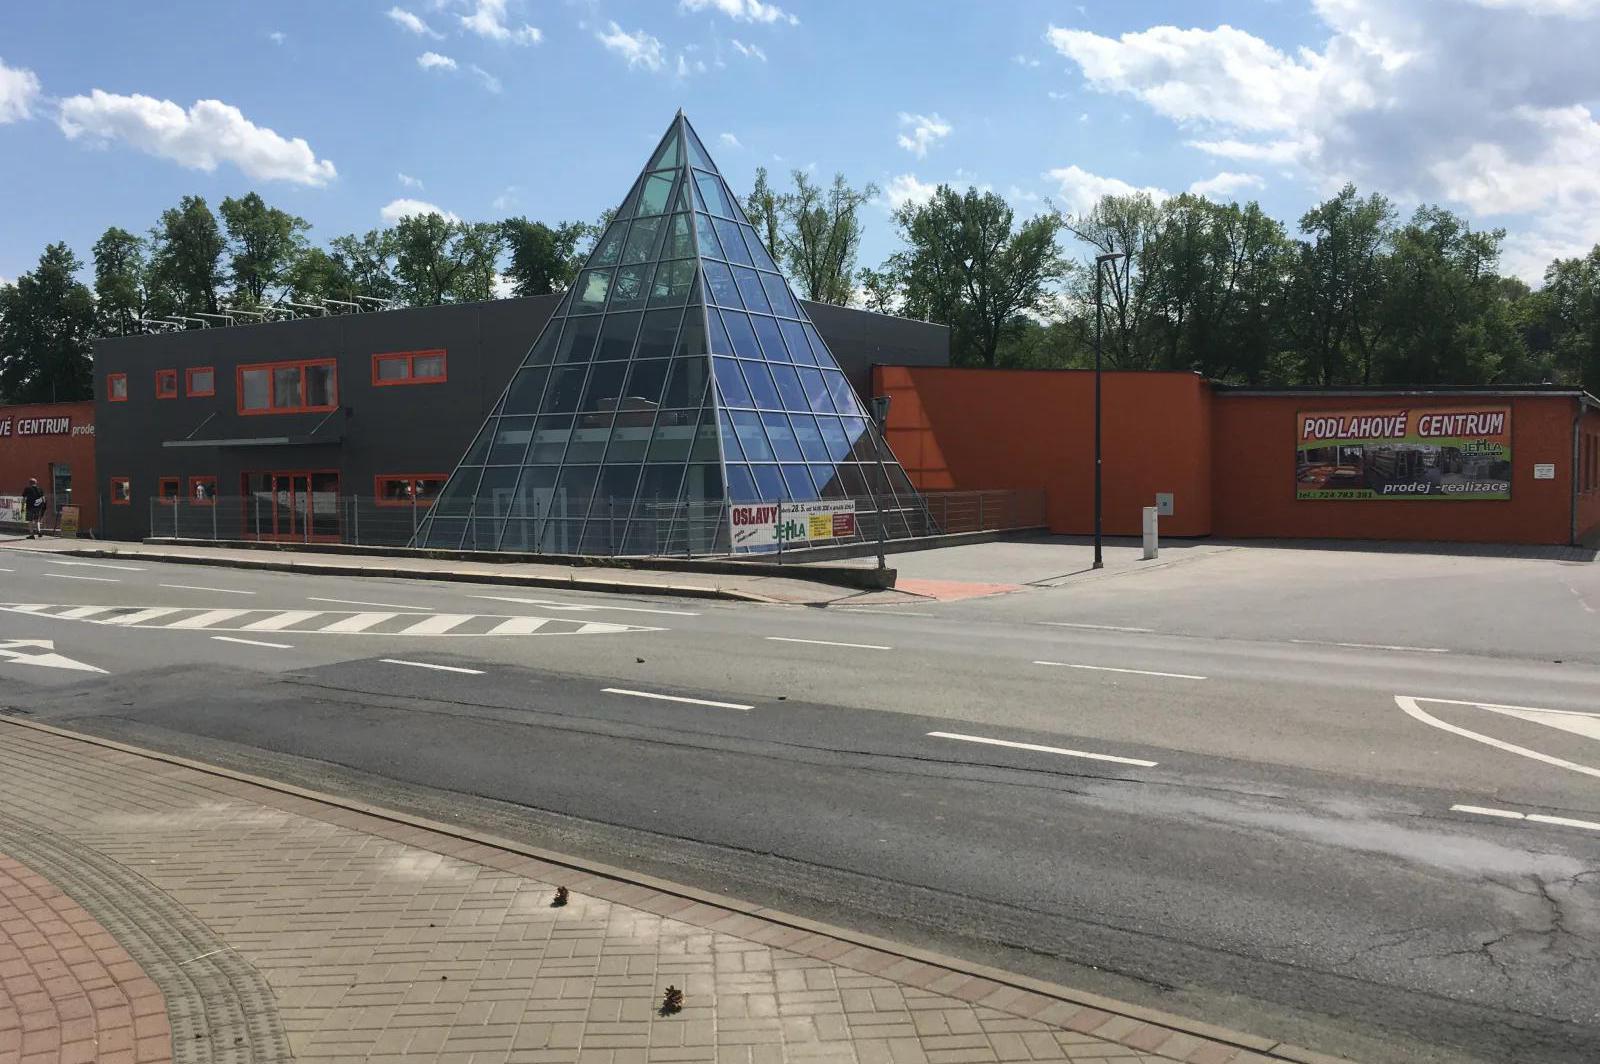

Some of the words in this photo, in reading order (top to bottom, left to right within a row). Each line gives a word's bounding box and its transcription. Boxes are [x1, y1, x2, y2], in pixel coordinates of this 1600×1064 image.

[17, 418, 70, 435] CENTRUM
[1303, 412, 1408, 439] PODLAHOVÉ
[1418, 413, 1504, 436] CENTRUM
[1383, 481, 1430, 494] prodej
[732, 507, 778, 526] OSLAVY
[772, 520, 806, 540] JEHLA
